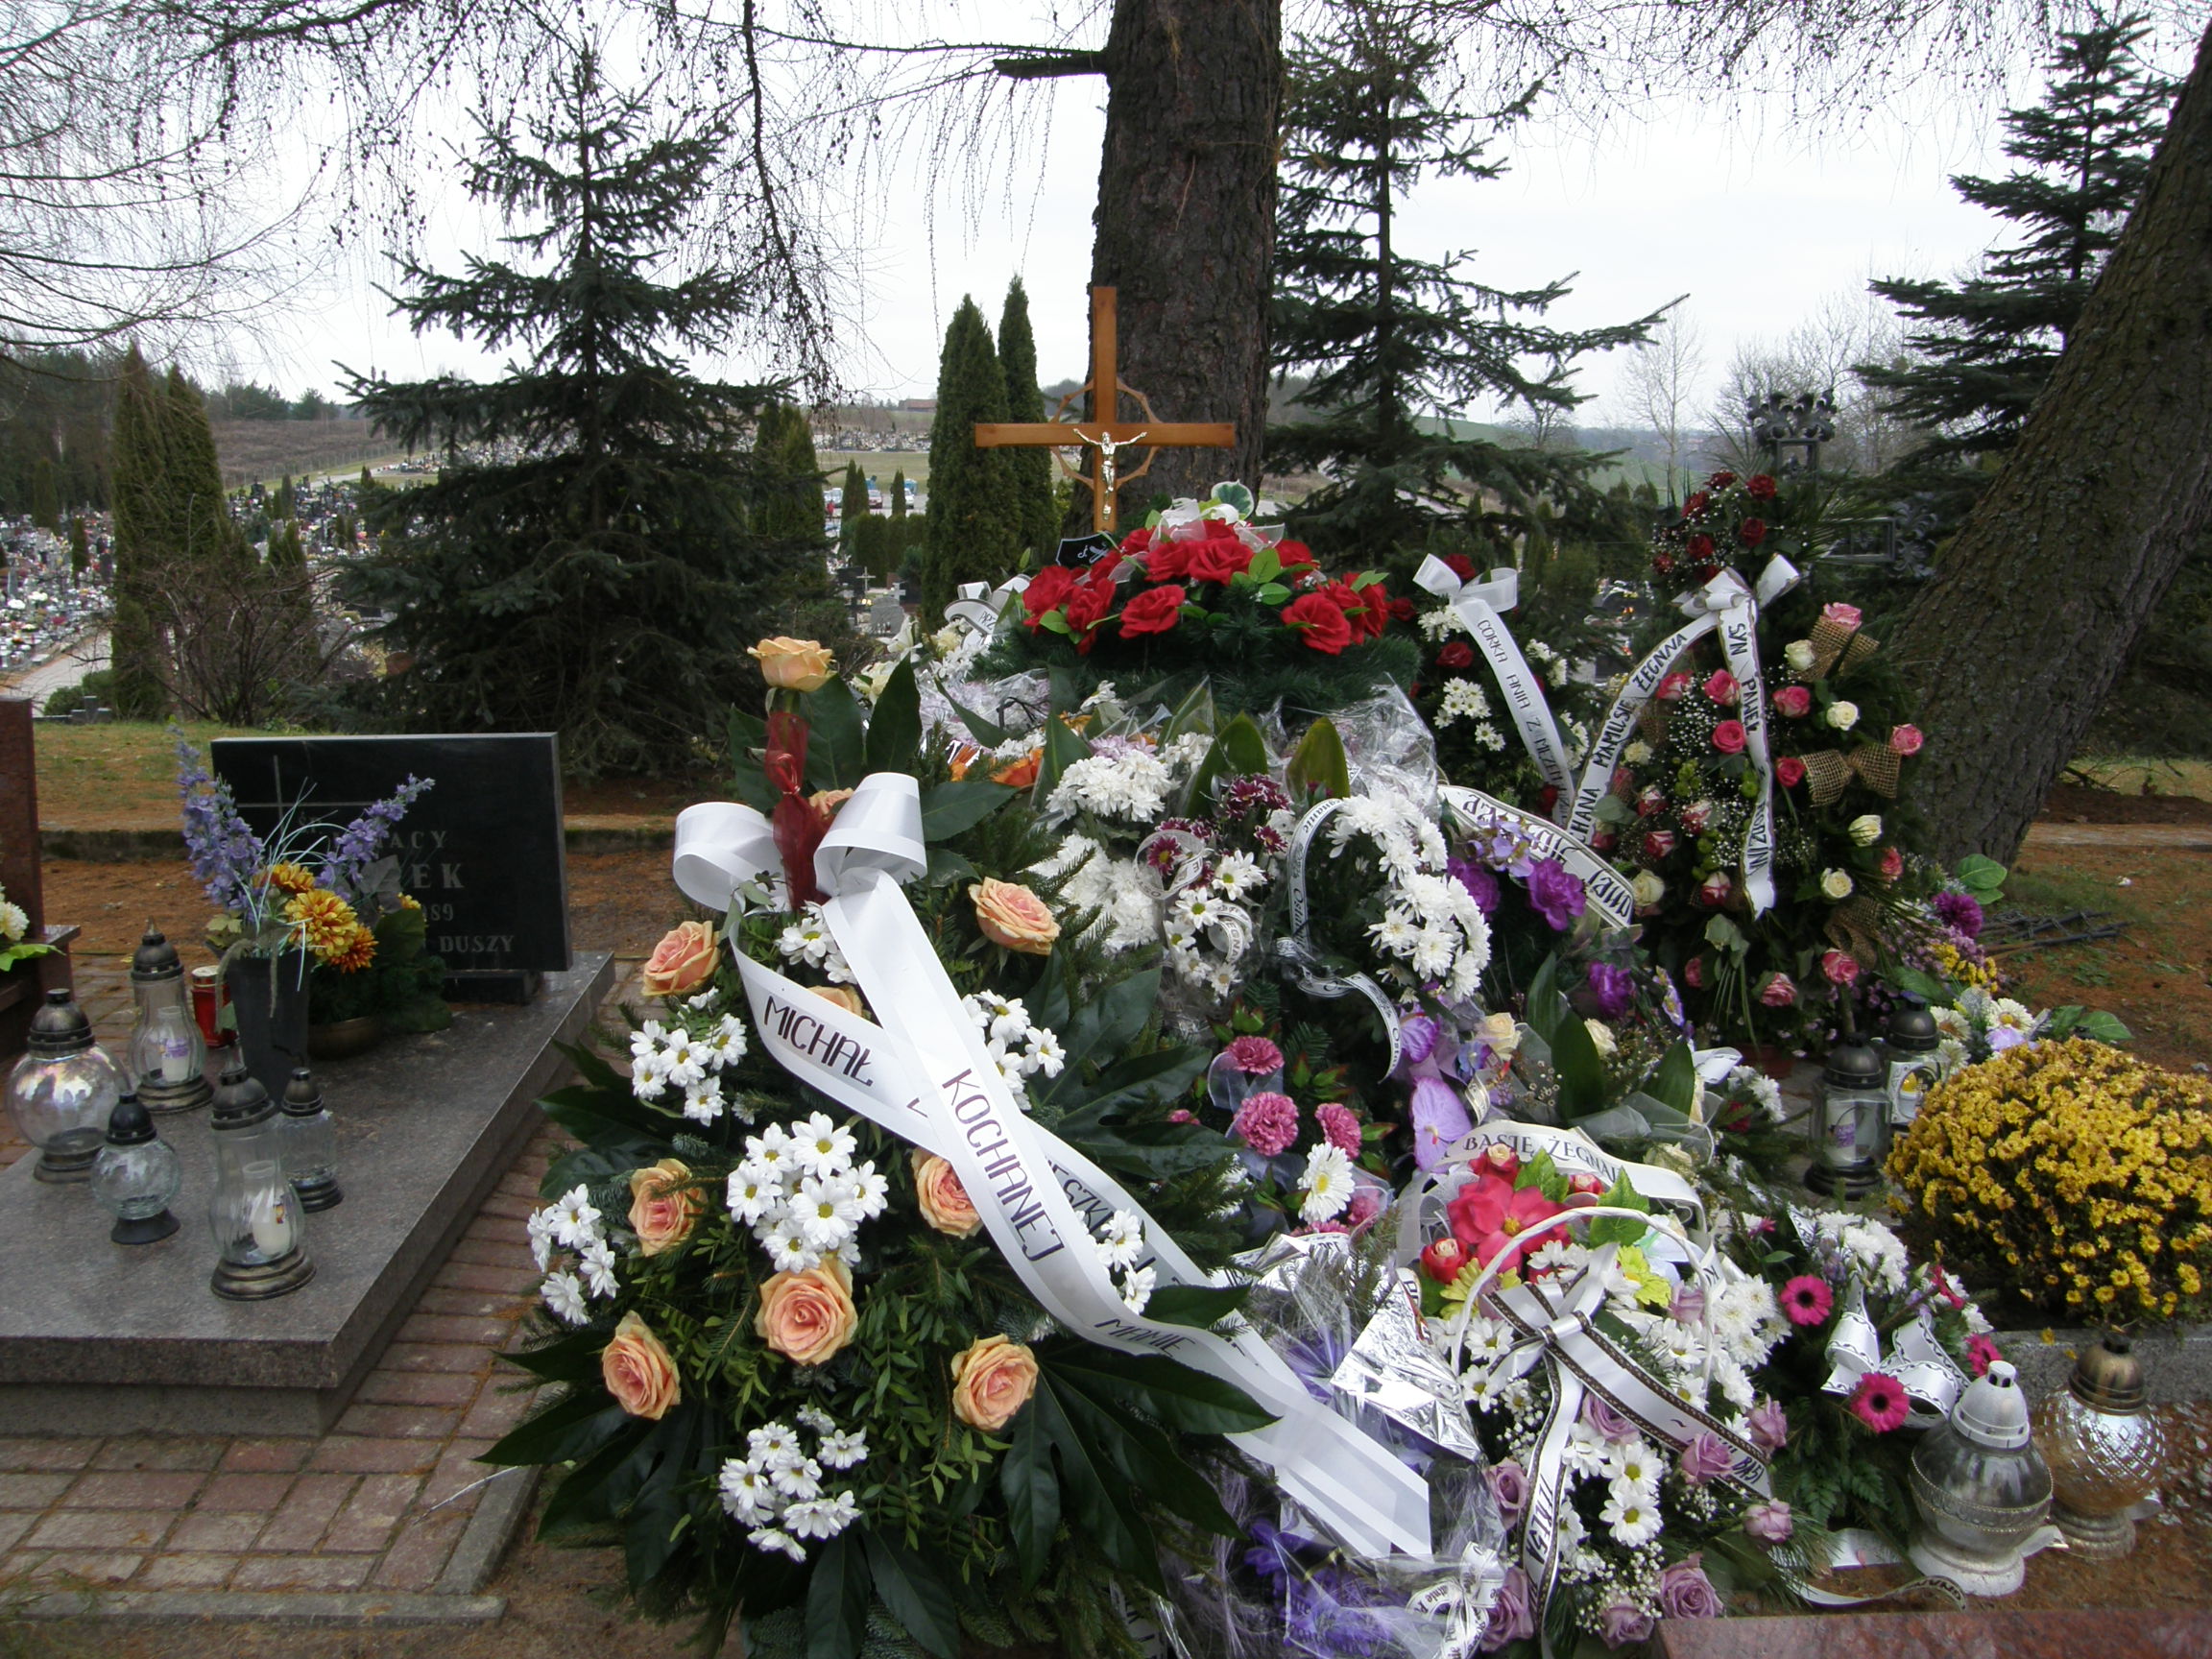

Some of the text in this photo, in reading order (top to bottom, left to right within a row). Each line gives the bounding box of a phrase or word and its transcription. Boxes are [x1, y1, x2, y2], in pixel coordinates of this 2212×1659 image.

[1727, 622, 1748, 657] SYN
[1505, 673, 1532, 710] ANIA
[438, 934, 516, 953] DUSZY
[763, 994, 874, 1088] MICHAŁ
[941, 1068, 1066, 1263] KOCHANEJ
